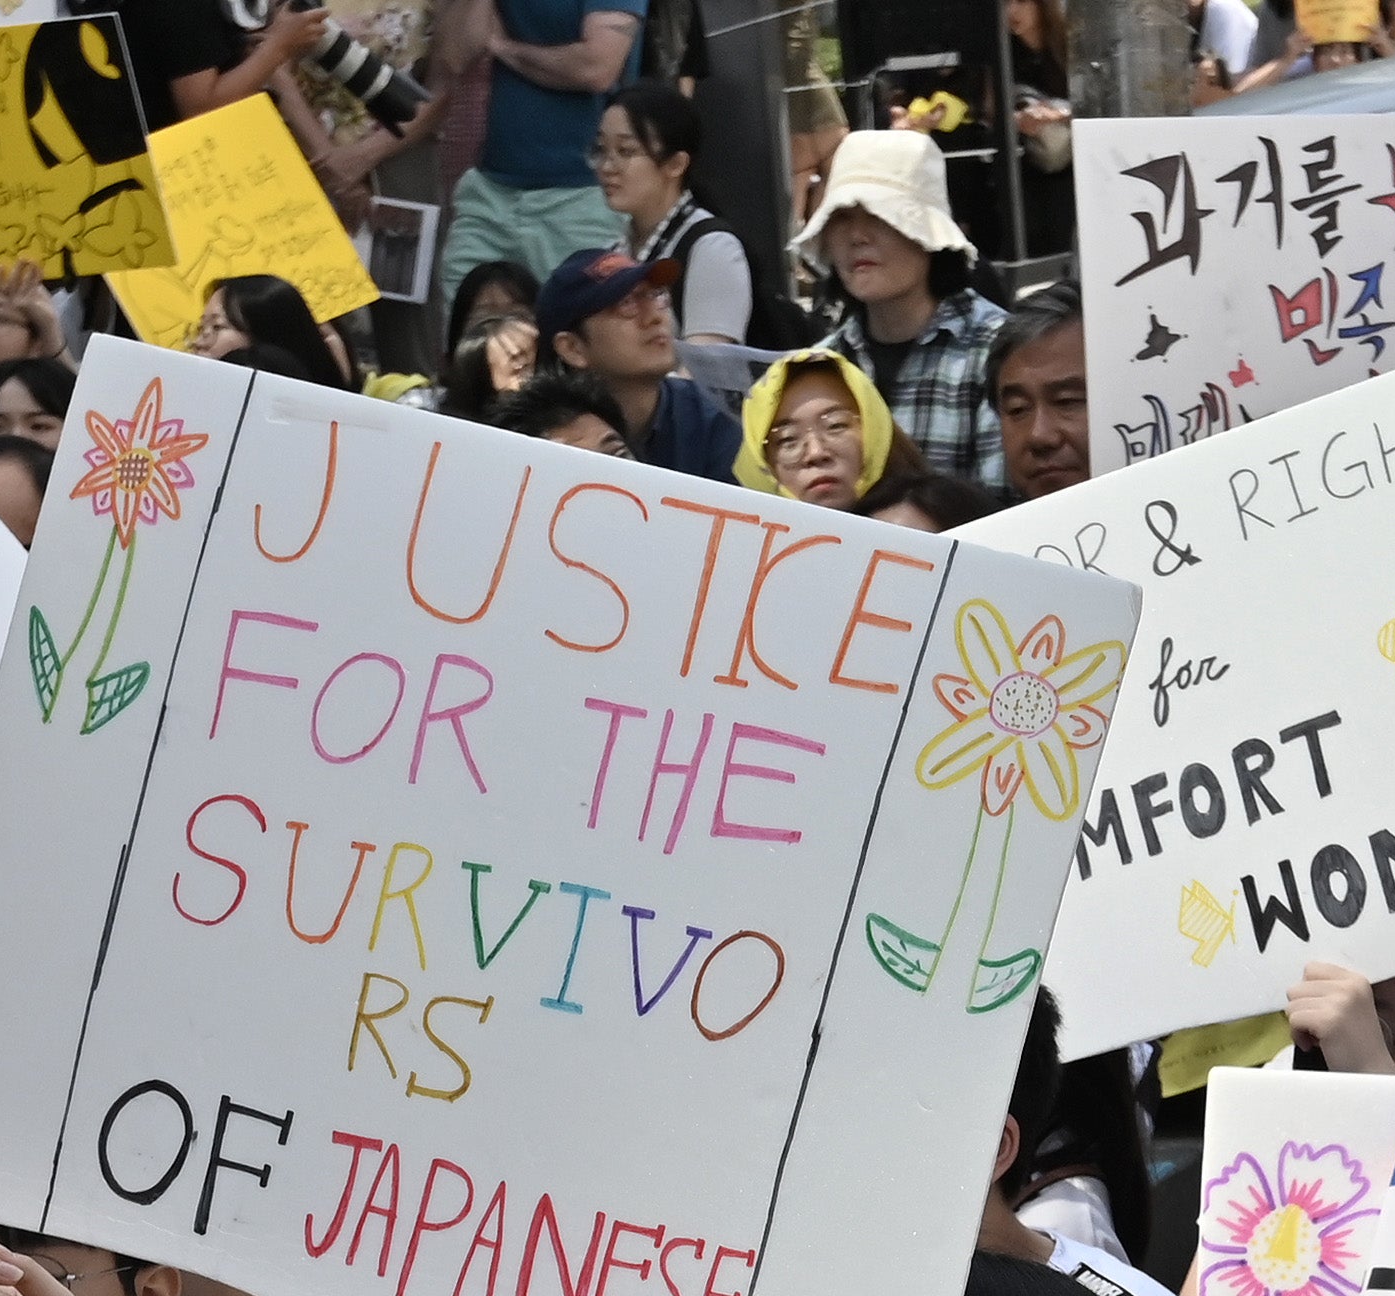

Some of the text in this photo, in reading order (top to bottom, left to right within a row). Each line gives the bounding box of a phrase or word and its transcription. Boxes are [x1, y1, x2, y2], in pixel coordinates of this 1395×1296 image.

[1115, 135, 1363, 287] 과거를
[1113, 382, 1274, 467] 미래
[255, 420, 933, 694] JUSTICE
[1145, 500, 1202, 576] &
[209, 609, 826, 854] FOR THE
[1150, 638, 1230, 727] for
[172, 794, 784, 1042] SURVIVO
[347, 972, 494, 1102] RS
[97, 1079, 294, 1235] OF
